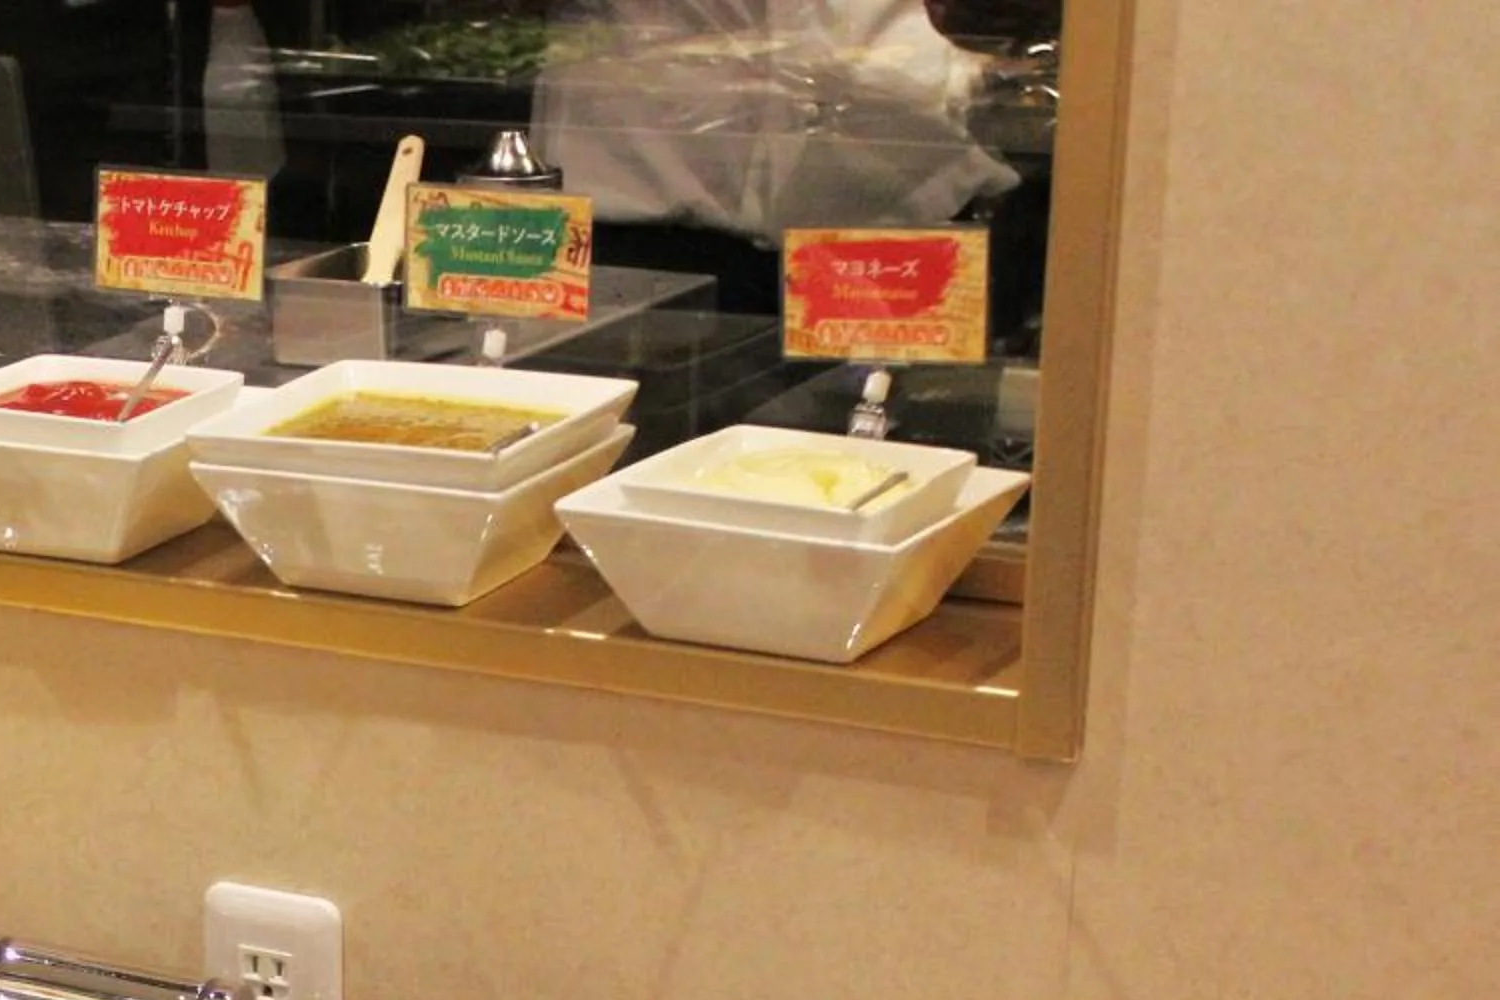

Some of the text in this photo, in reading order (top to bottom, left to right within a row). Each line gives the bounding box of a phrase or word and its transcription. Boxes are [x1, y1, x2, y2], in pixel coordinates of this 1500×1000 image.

[120, 197, 231, 222] トマトケチャップ
[435, 223, 557, 246] マスタードソース
[830, 258, 921, 279] マヨネーズ
